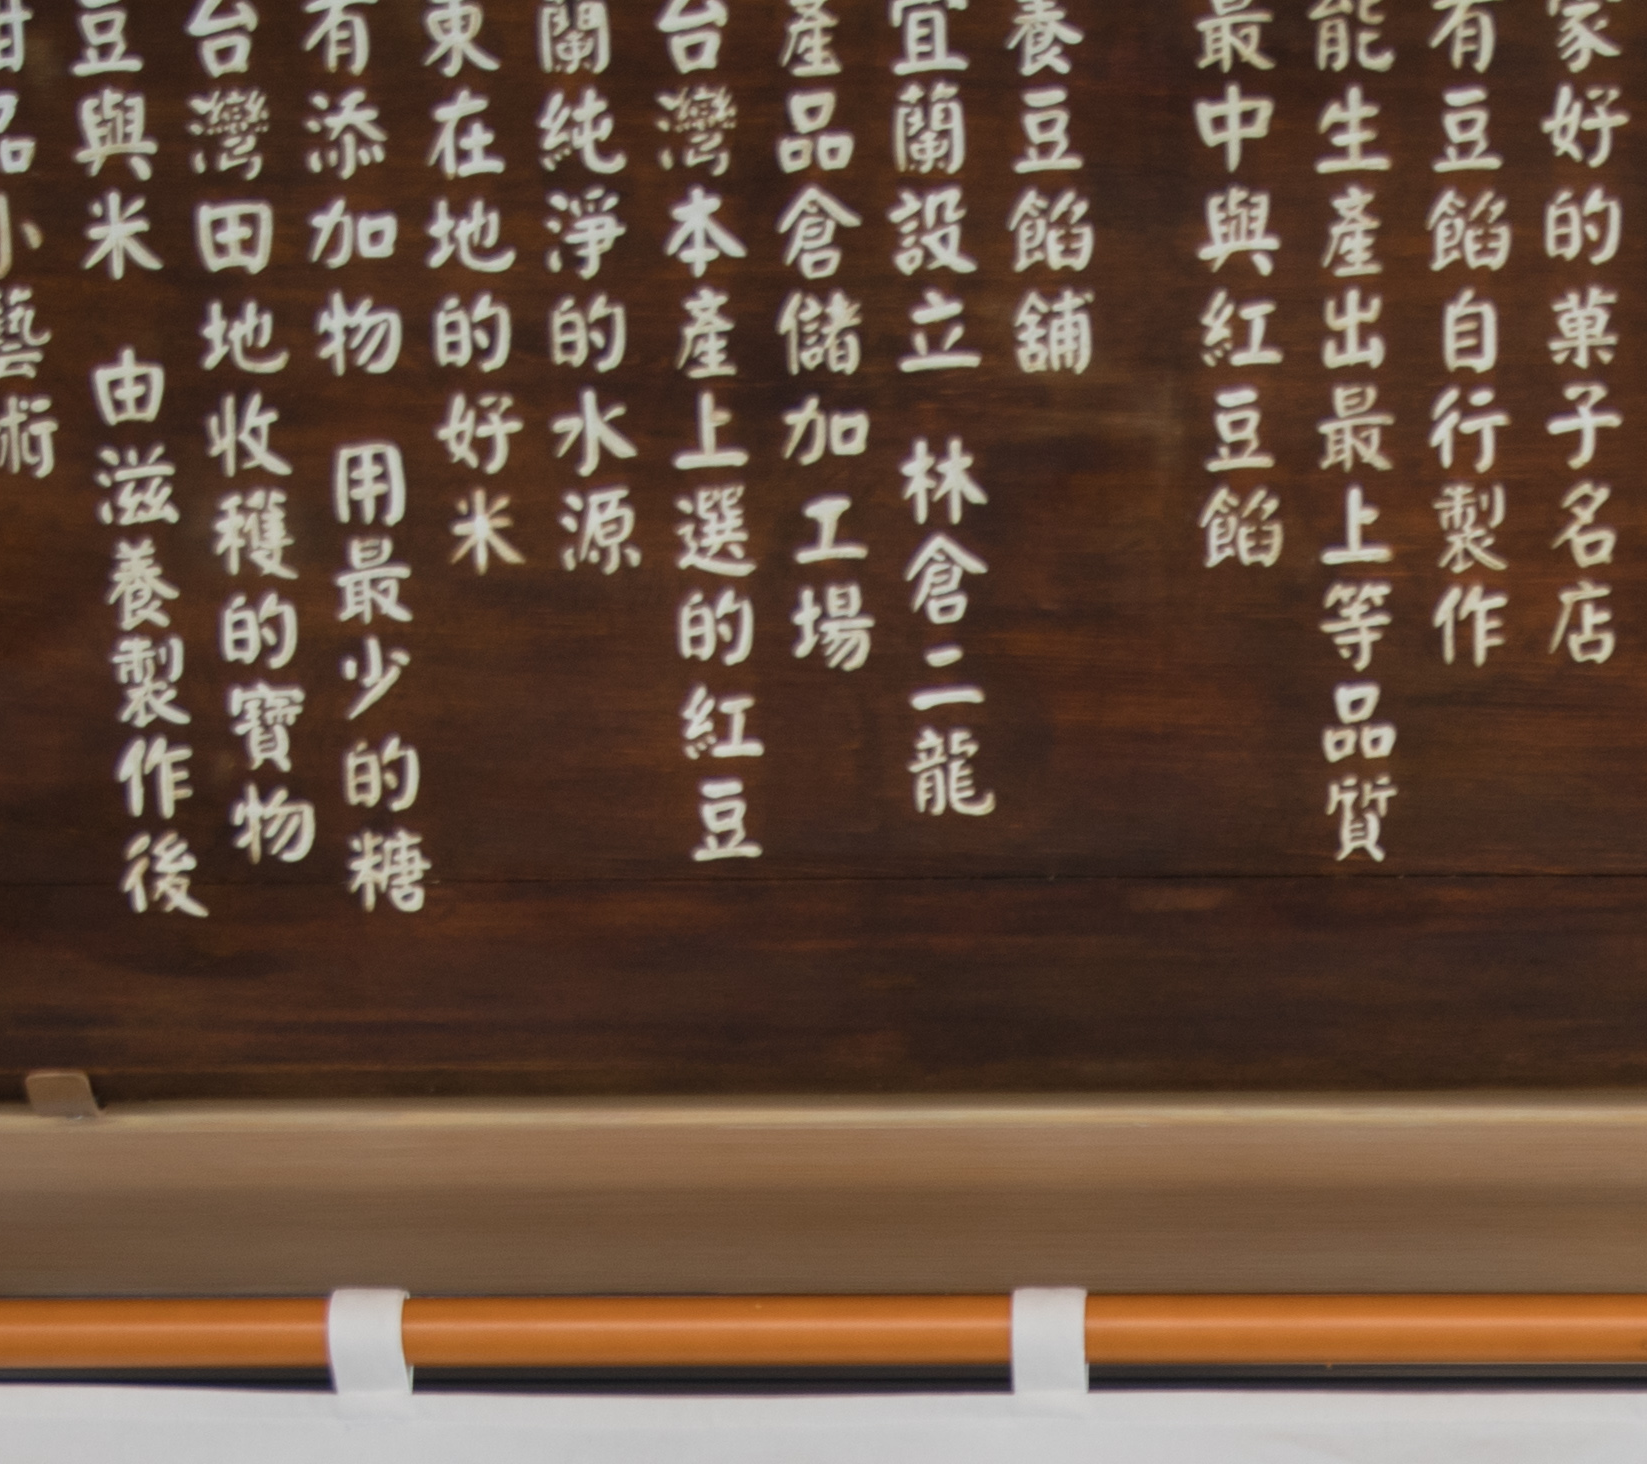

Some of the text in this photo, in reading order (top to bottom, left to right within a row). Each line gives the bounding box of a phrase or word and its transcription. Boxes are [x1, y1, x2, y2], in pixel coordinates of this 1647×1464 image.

[72, 0, 208, 916] 豆與米 由滋養製作後
[305, 0, 431, 912] 有添加物 用最少的糖
[425, 0, 524, 573] 東在地的好米
[539, 0, 641, 574] 蘭純淨的水源
[888, 0, 981, 372] 宜蘭設立
[1008, 0, 1094, 374] 養豆餡舖
[1196, 0, 1283, 567] 最中與紅豆餡
